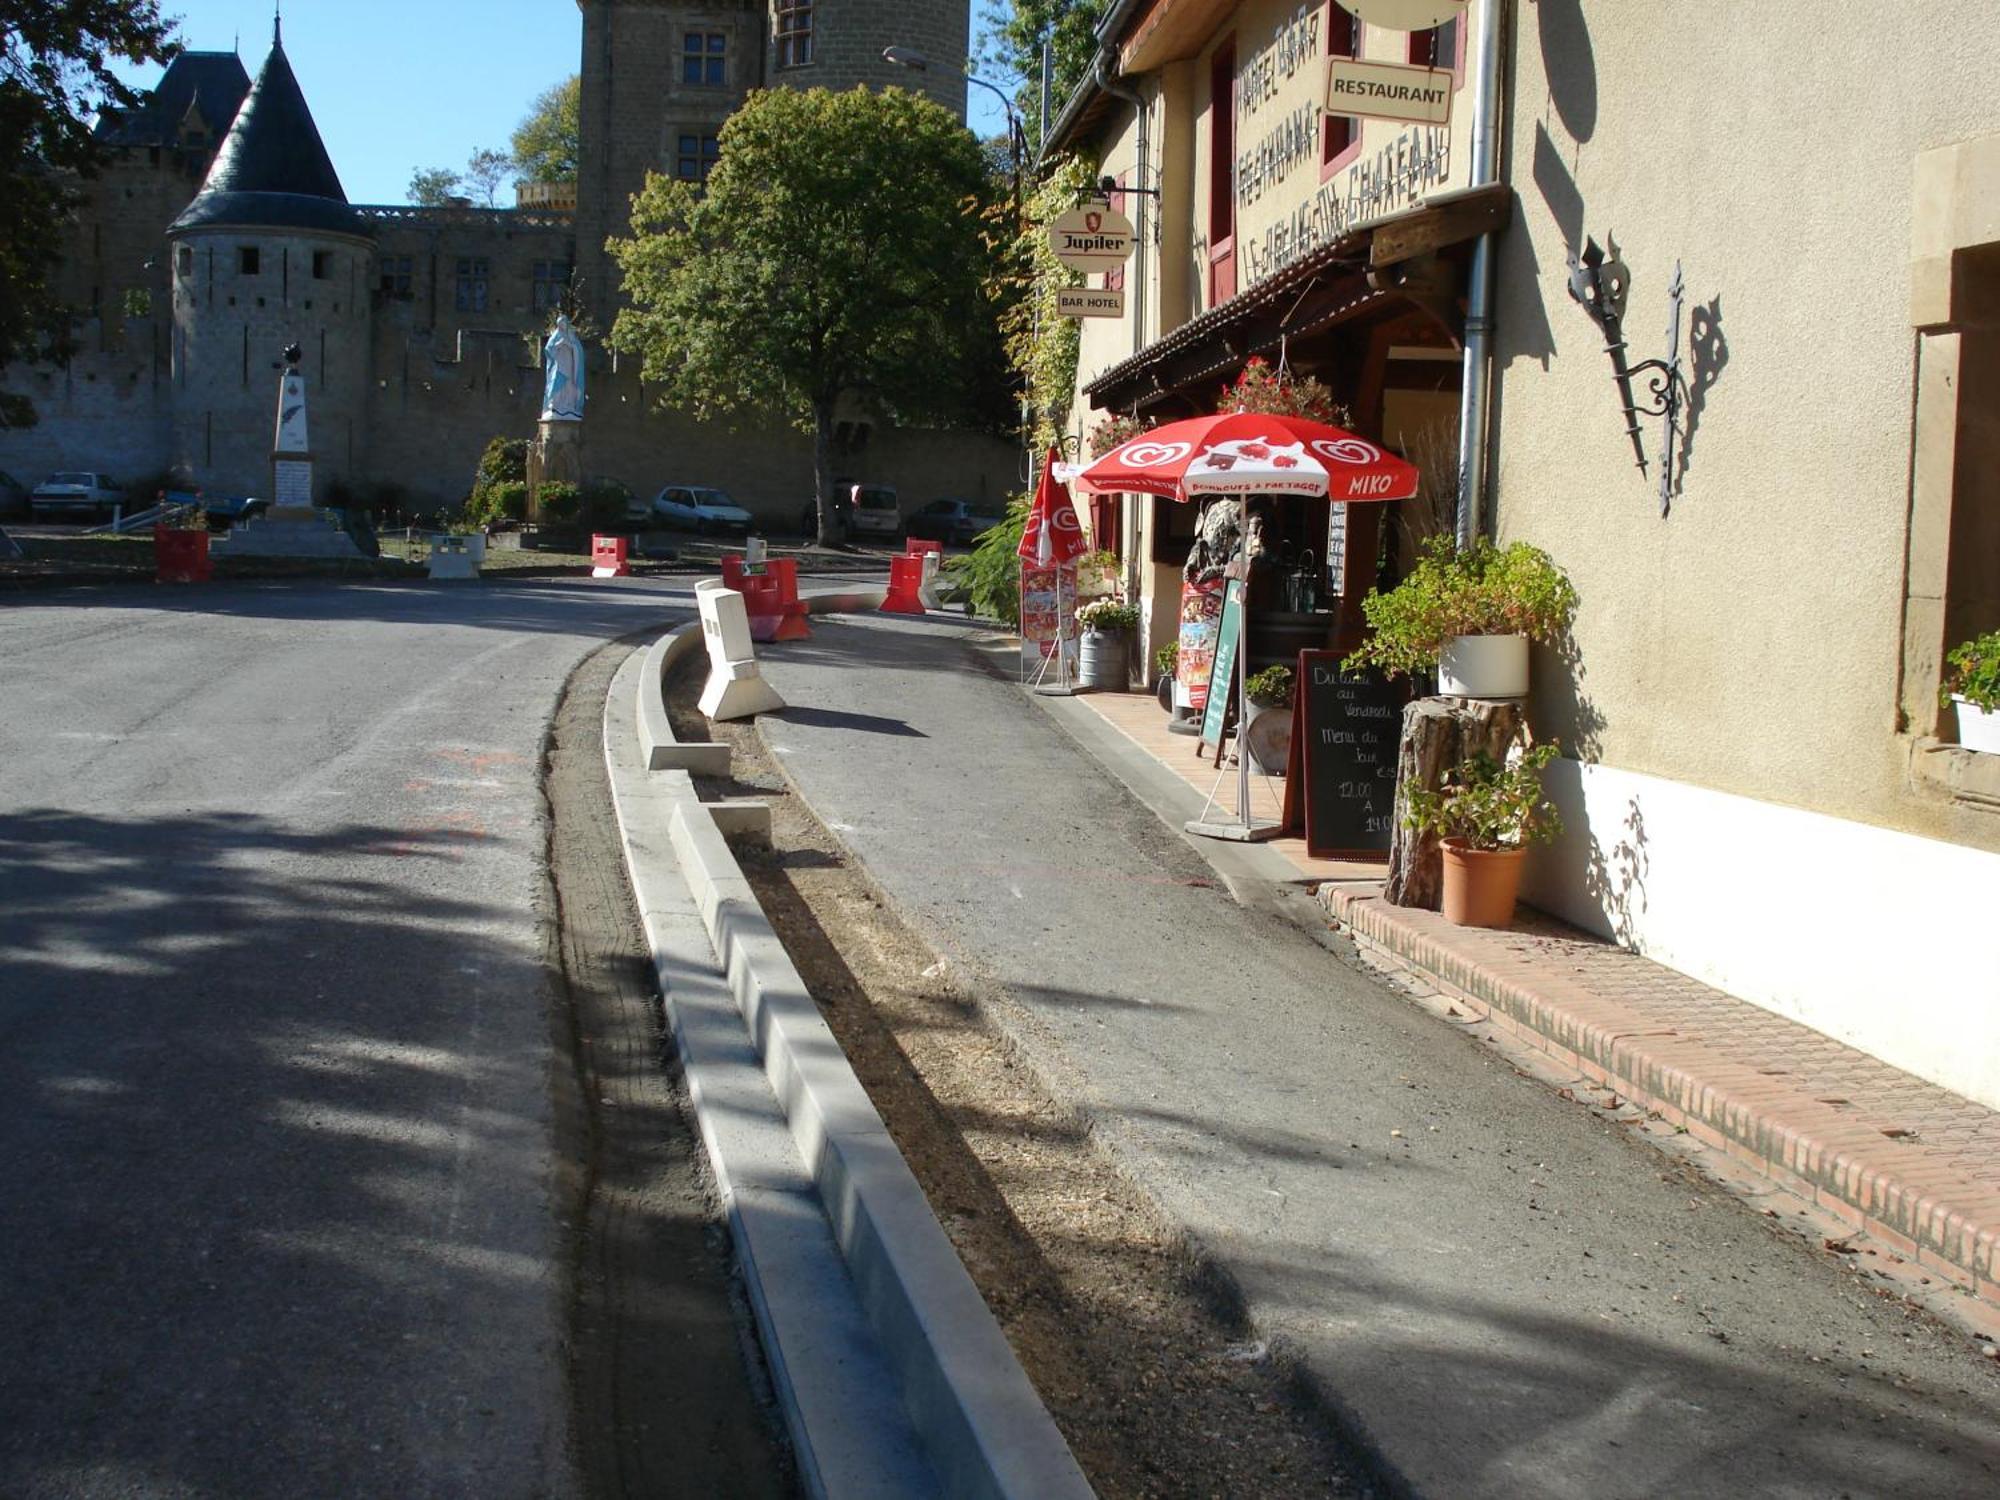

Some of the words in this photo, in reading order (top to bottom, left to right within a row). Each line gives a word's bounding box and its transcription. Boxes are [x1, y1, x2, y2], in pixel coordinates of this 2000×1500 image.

[1334, 78, 1445, 104] RESTAURANT
[1063, 235, 1125, 252] Jupiler
[1062, 297, 1083, 307] BAR
[1087, 298, 1119, 309] HOTEL
[1348, 475, 1392, 495] MIKO
